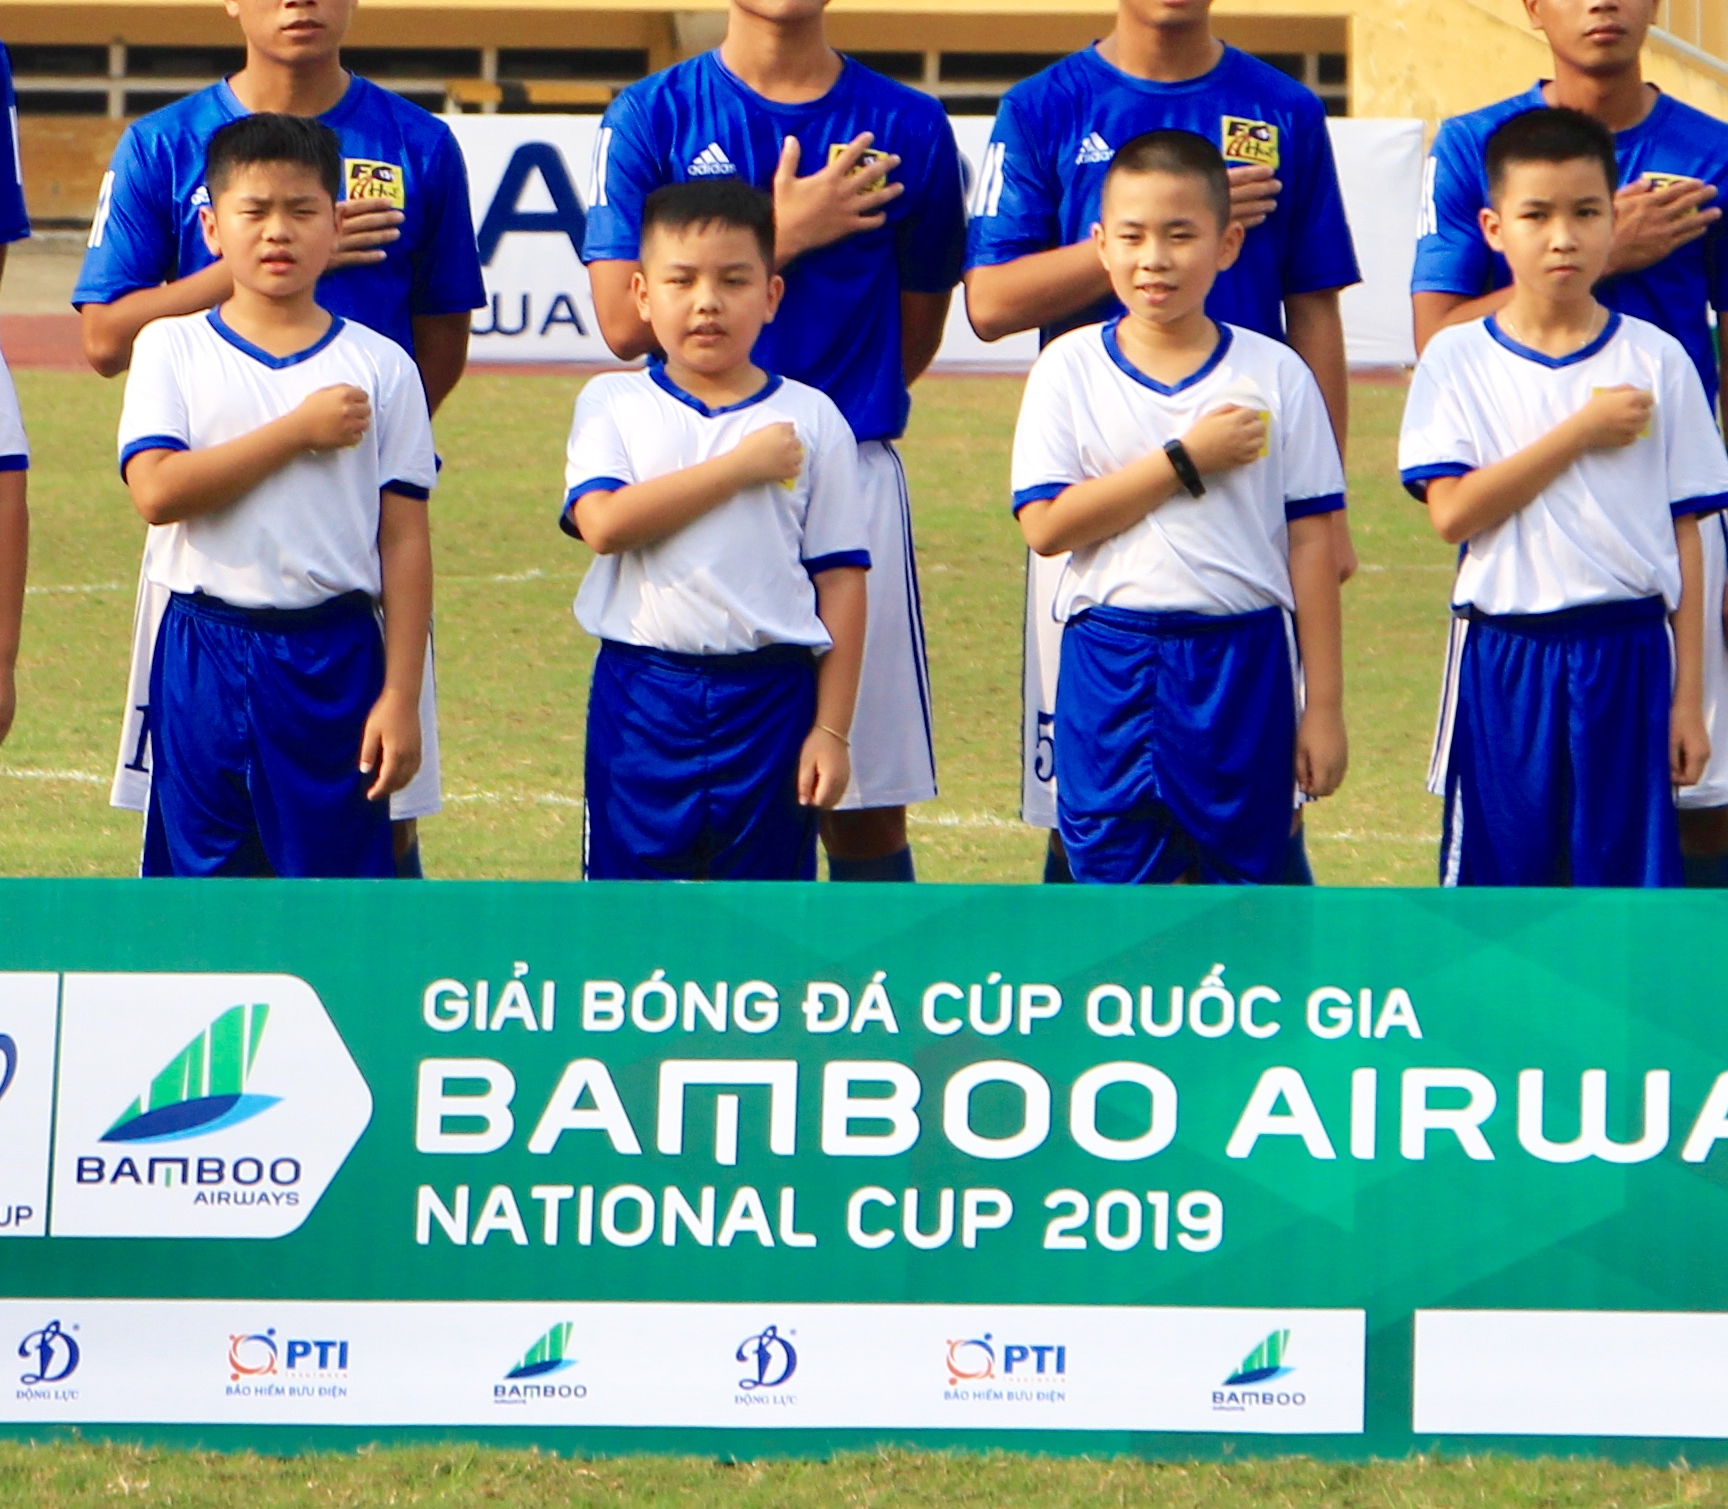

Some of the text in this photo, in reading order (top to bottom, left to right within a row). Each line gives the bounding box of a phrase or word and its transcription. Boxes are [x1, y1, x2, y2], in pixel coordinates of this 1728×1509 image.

[423, 961, 1424, 1040] GIẢI BÓNG ĐÁ CÚP QUỐC GIA
[414, 1057, 1179, 1167] BAMBOO
[76, 1156, 302, 1188] BAMBOO
[193, 1190, 301, 1206] AIRWAYS
[415, 1184, 1225, 1253] NATIONAL CUP 2019
[286, 1340, 349, 1370] PTI
[1004, 1345, 1066, 1374] PTI
[493, 1384, 588, 1399] BAMBOO
[1211, 1391, 1306, 1406] BAMBOO
